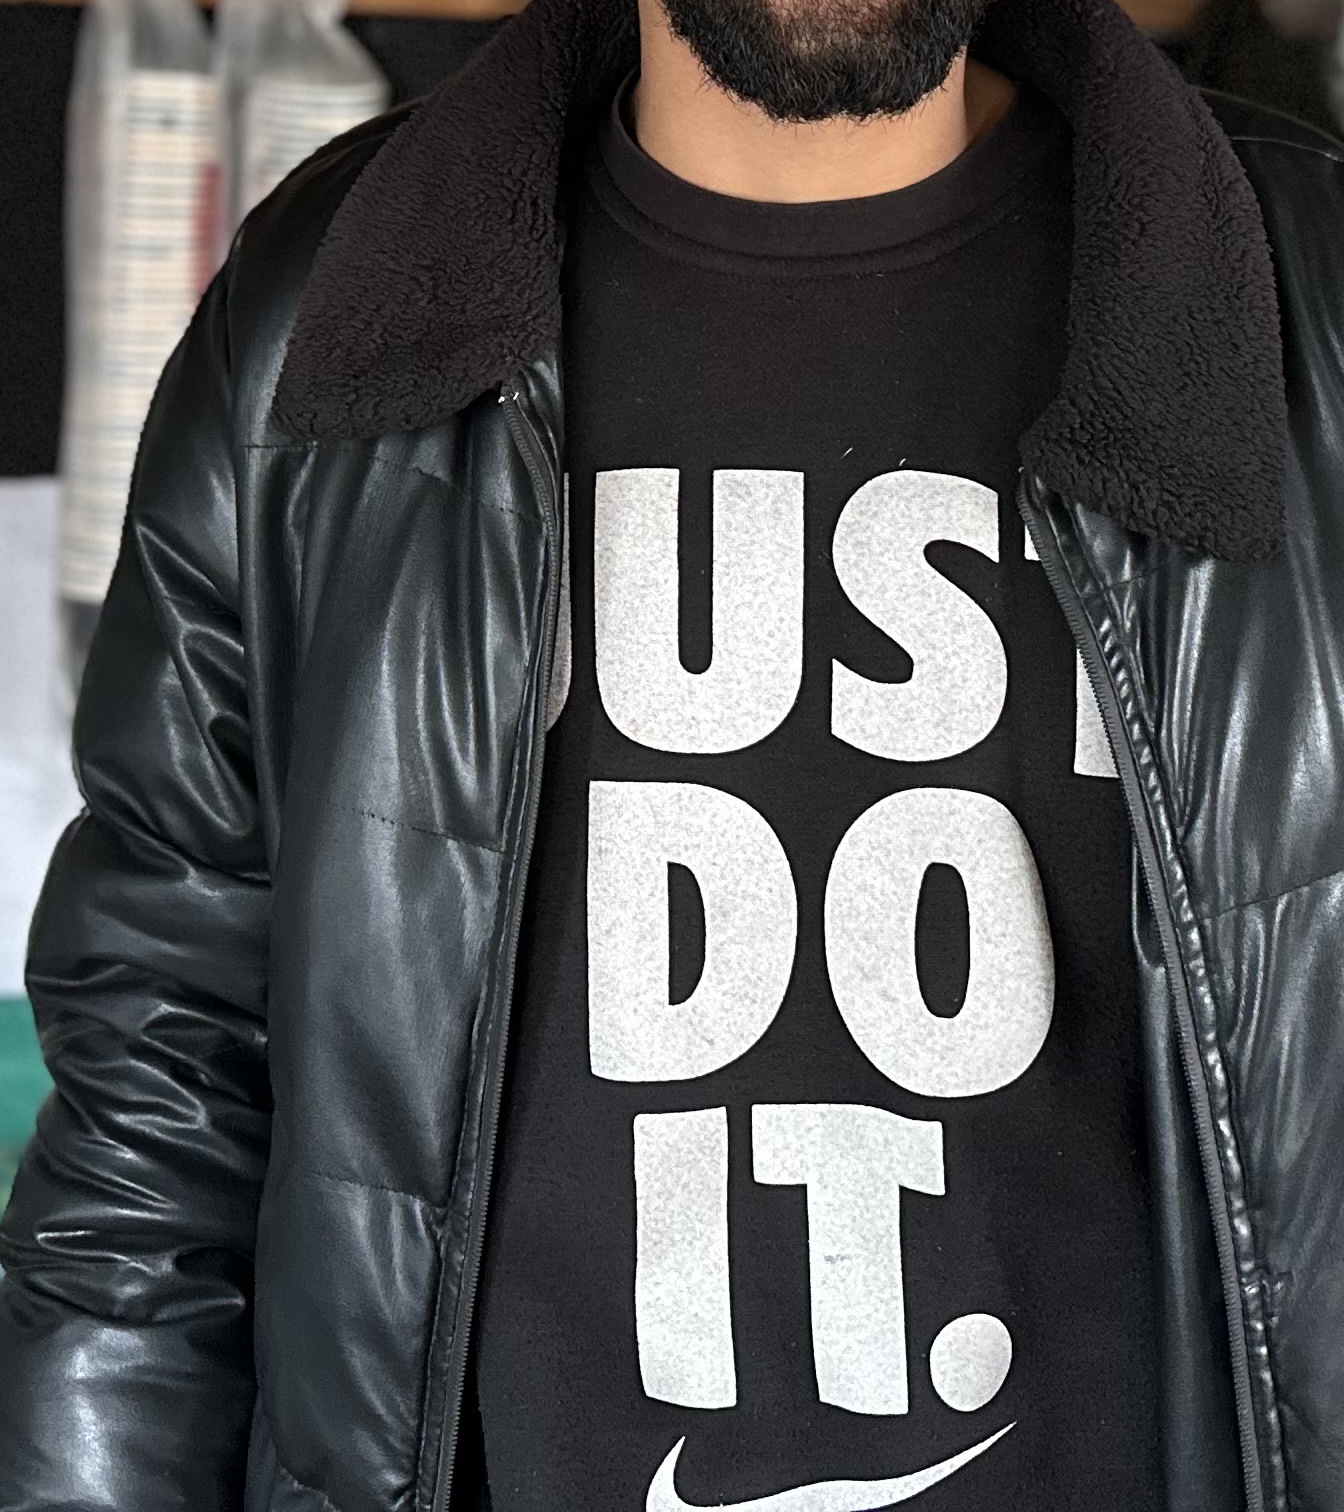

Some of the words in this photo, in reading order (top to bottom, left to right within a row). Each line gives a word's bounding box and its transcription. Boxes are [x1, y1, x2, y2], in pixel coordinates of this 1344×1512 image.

[546, 467, 1122, 777] US
[587, 780, 1055, 1098] DO
[633, 1103, 1013, 1414] IT.
